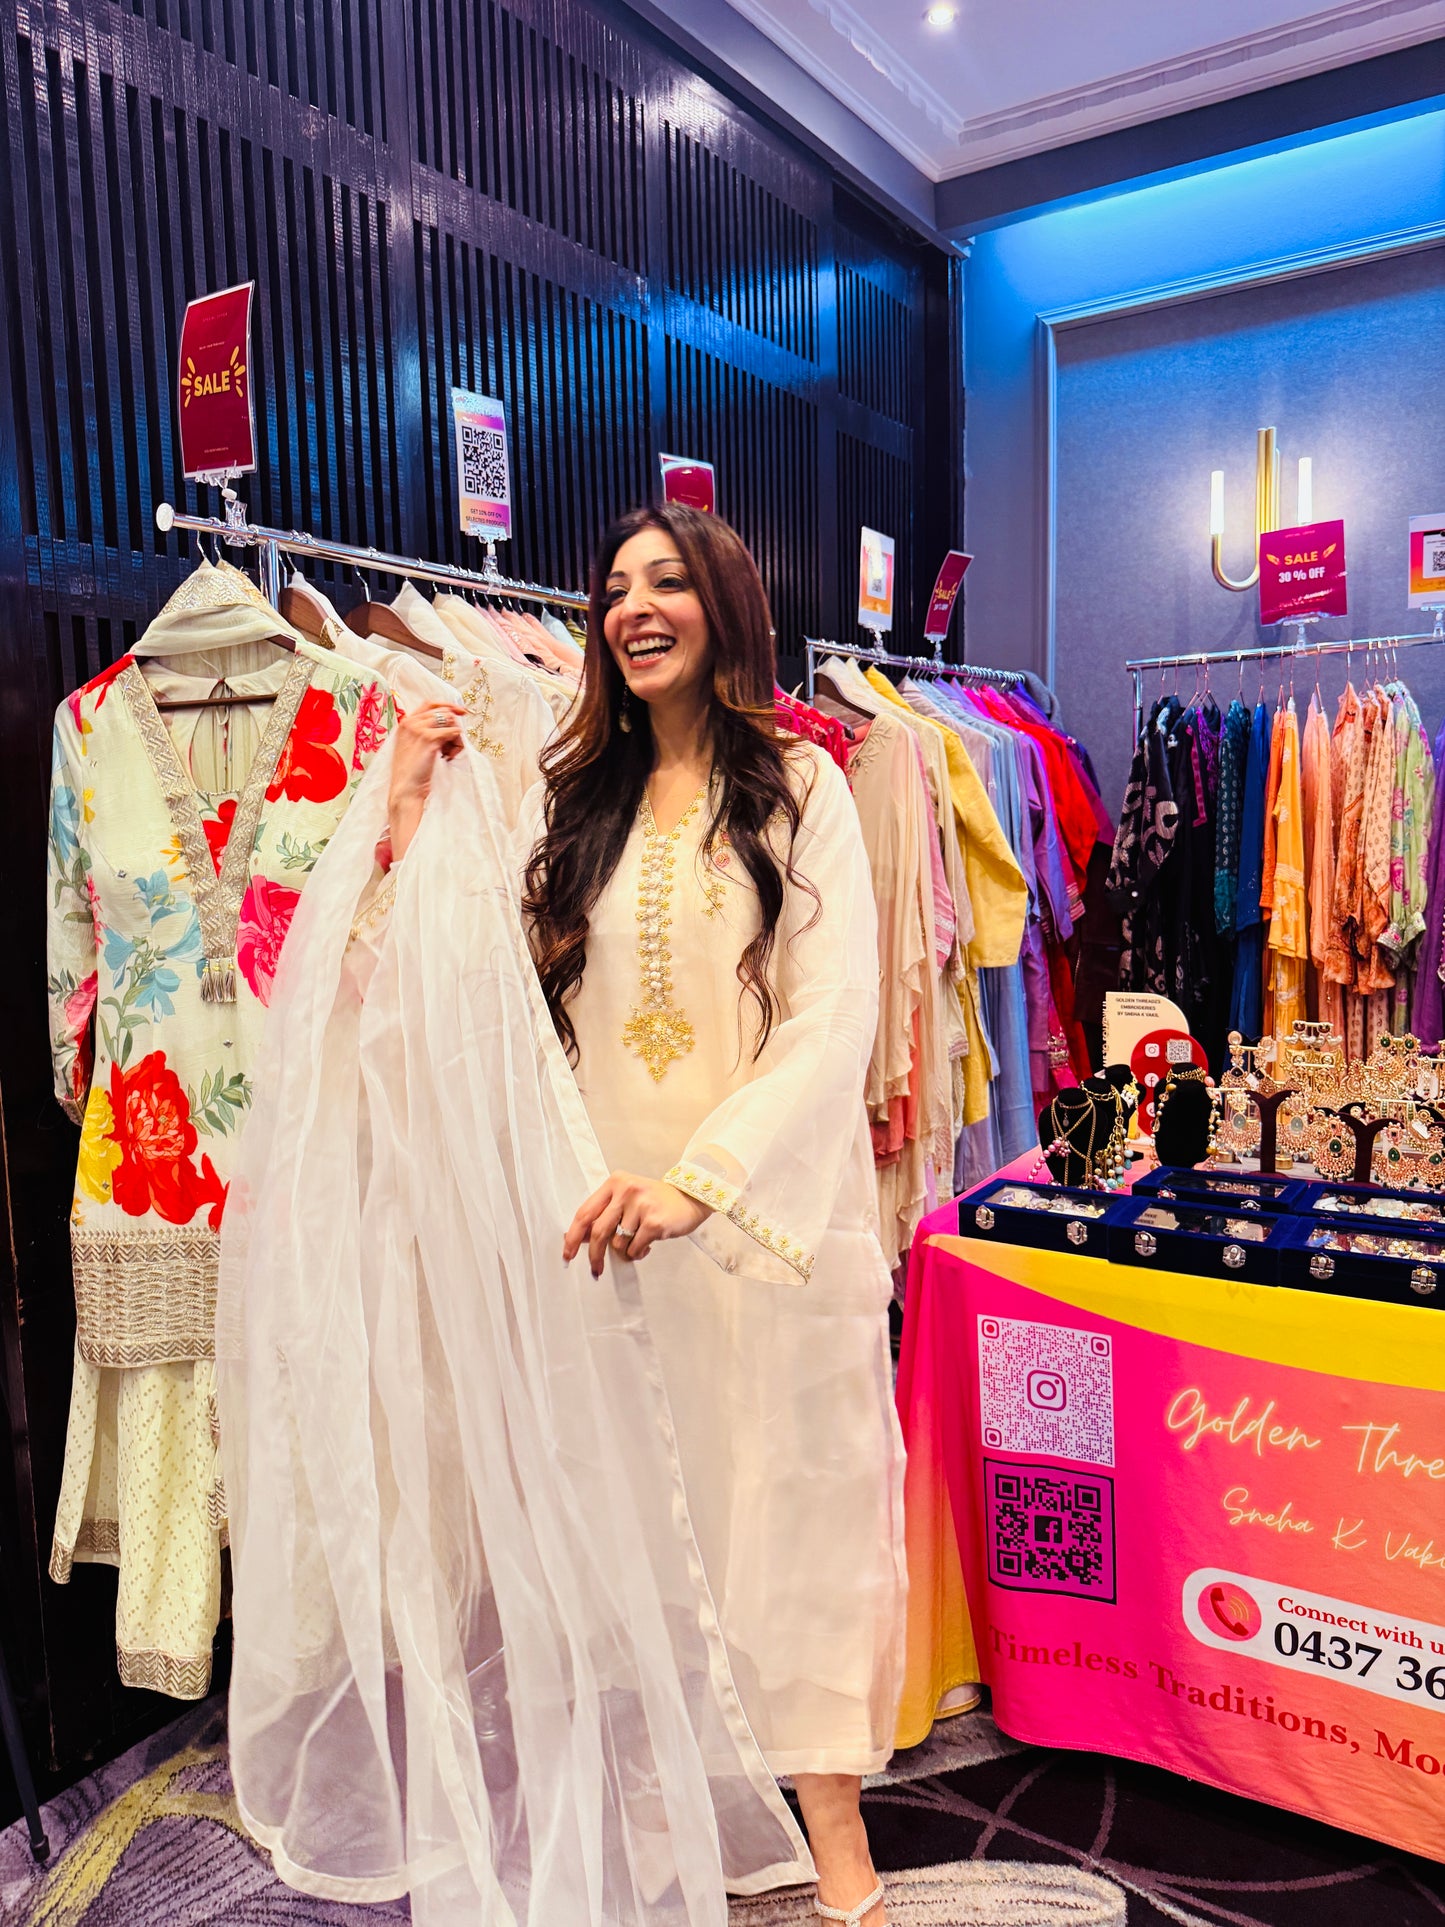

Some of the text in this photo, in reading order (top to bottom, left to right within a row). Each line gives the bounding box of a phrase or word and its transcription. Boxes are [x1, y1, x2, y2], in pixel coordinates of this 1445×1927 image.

[194, 370, 230, 397] SALE
[1278, 566, 1325, 583] 30 % OFF
[1284, 550, 1319, 566] SALE
[1167, 1387, 1321, 1457] Golden
[1223, 1487, 1315, 1533] Sneha
[1331, 1517, 1368, 1550] K
[1277, 1597, 1368, 1634] Connect
[1374, 1626, 1424, 1649] with
[1274, 1622, 1445, 1700] 0437 36
[989, 1625, 1445, 1776] Timeless Traditions, Mo
